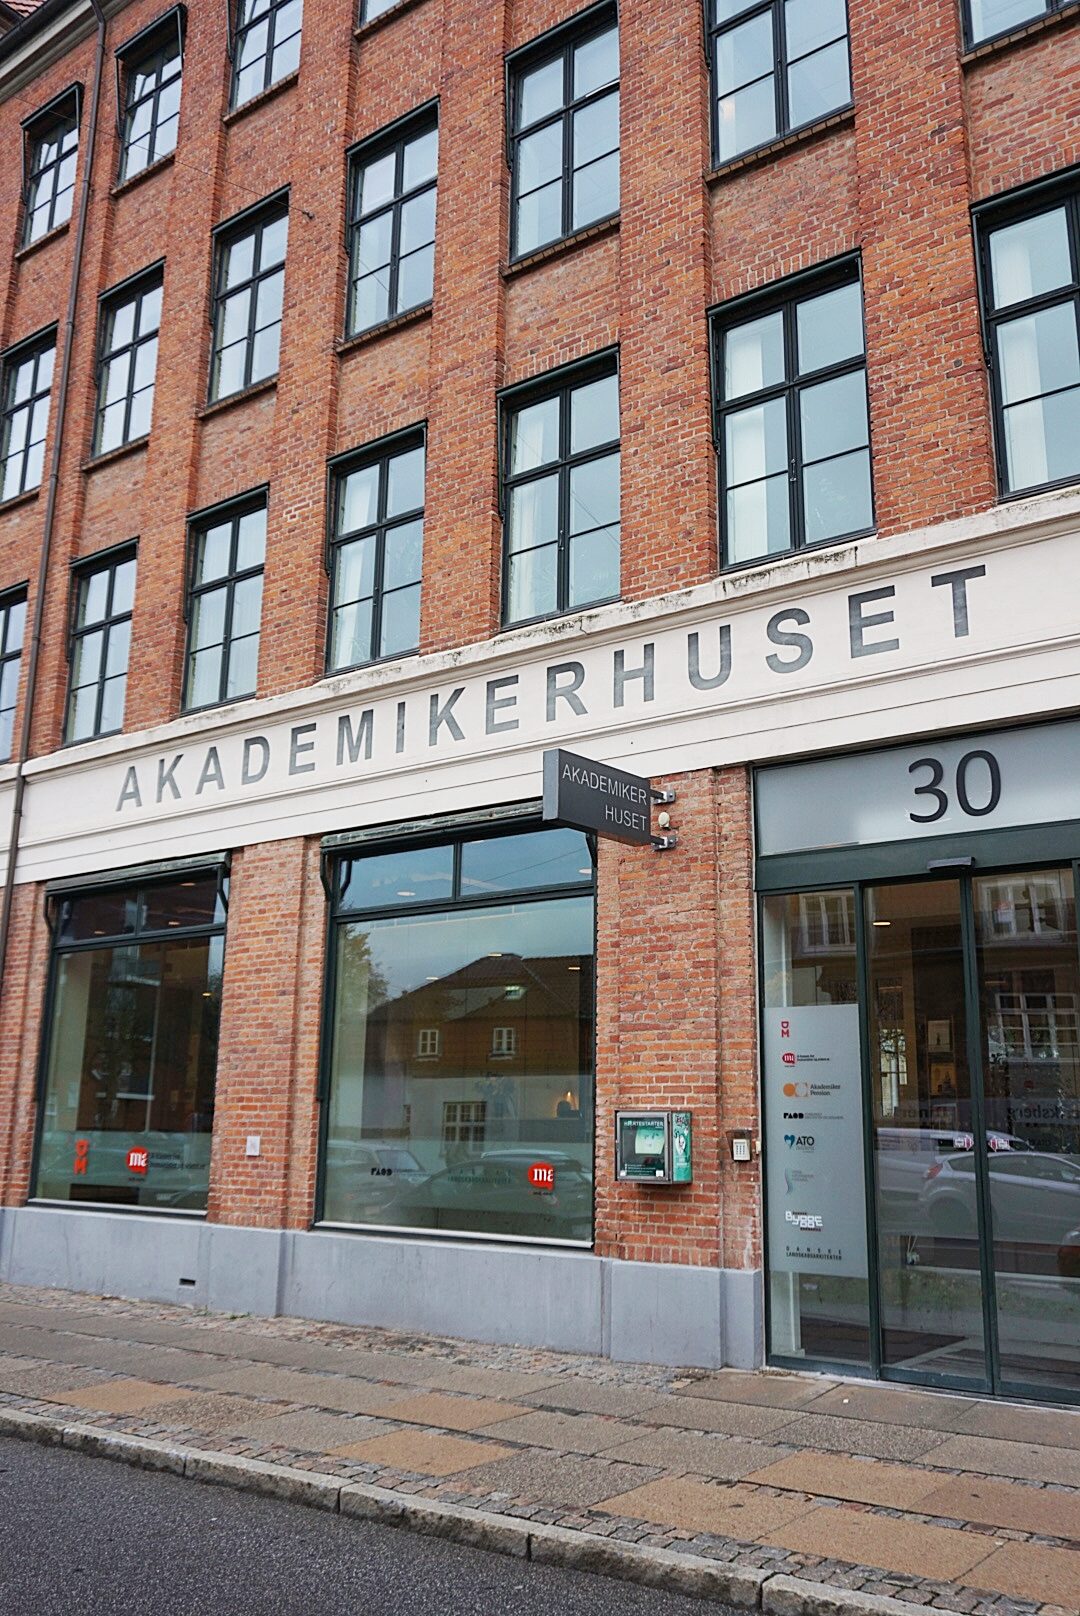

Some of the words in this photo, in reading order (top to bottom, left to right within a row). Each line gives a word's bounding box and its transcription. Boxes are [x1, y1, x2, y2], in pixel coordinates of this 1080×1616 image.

[117, 562, 987, 812] AKADEMIKERHUSET
[562, 763, 648, 806] AKADEMIKER
[909, 751, 1001, 840] 30
[605, 804, 648, 831] HUSET
[796, 1136, 815, 1146] ATO
